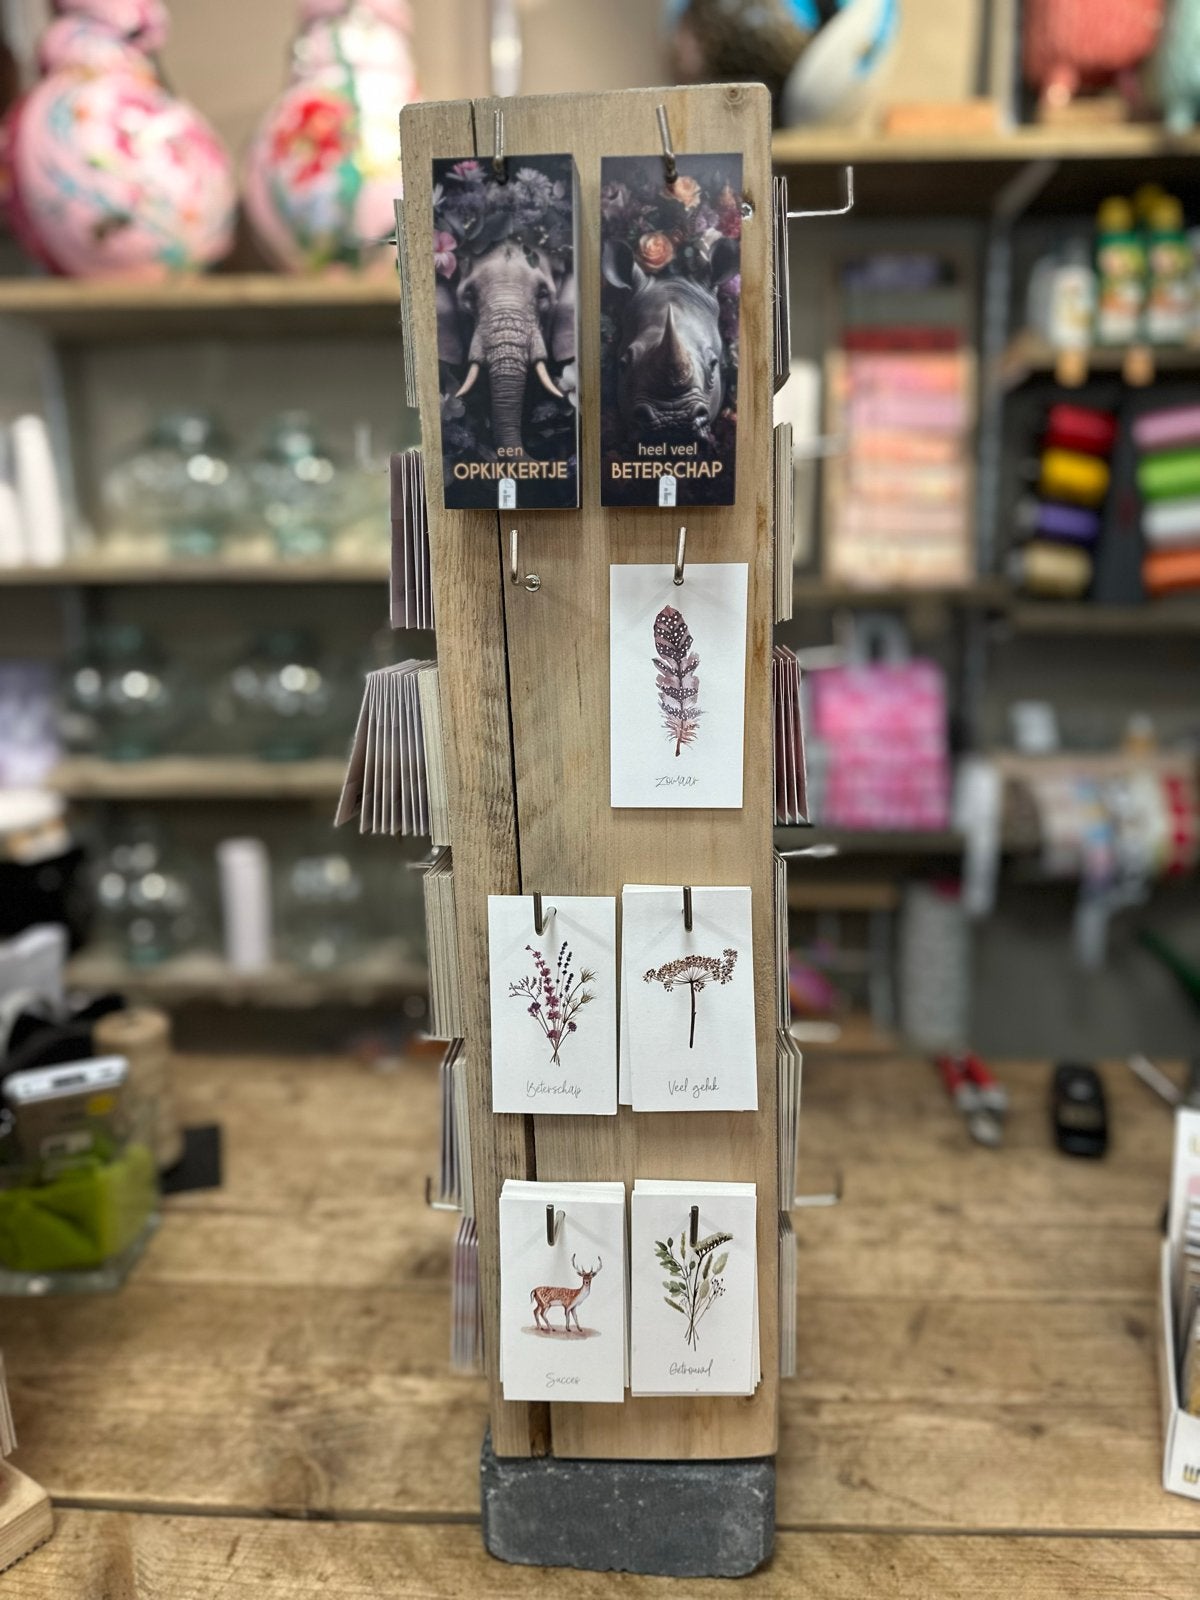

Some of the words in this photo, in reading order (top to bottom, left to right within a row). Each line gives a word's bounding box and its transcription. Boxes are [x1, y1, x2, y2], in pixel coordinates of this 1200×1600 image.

[497, 446, 523, 457] een
[638, 442, 667, 456] heel
[670, 442, 698, 456] veel
[453, 461, 568, 480] OPKIKKERTJE
[611, 461, 723, 479] BETERSCHAP
[526, 1079, 582, 1099] Beterschap
[668, 1077, 689, 1096] Veel
[692, 1076, 720, 1099] geluk
[545, 1371, 581, 1389] Succes
